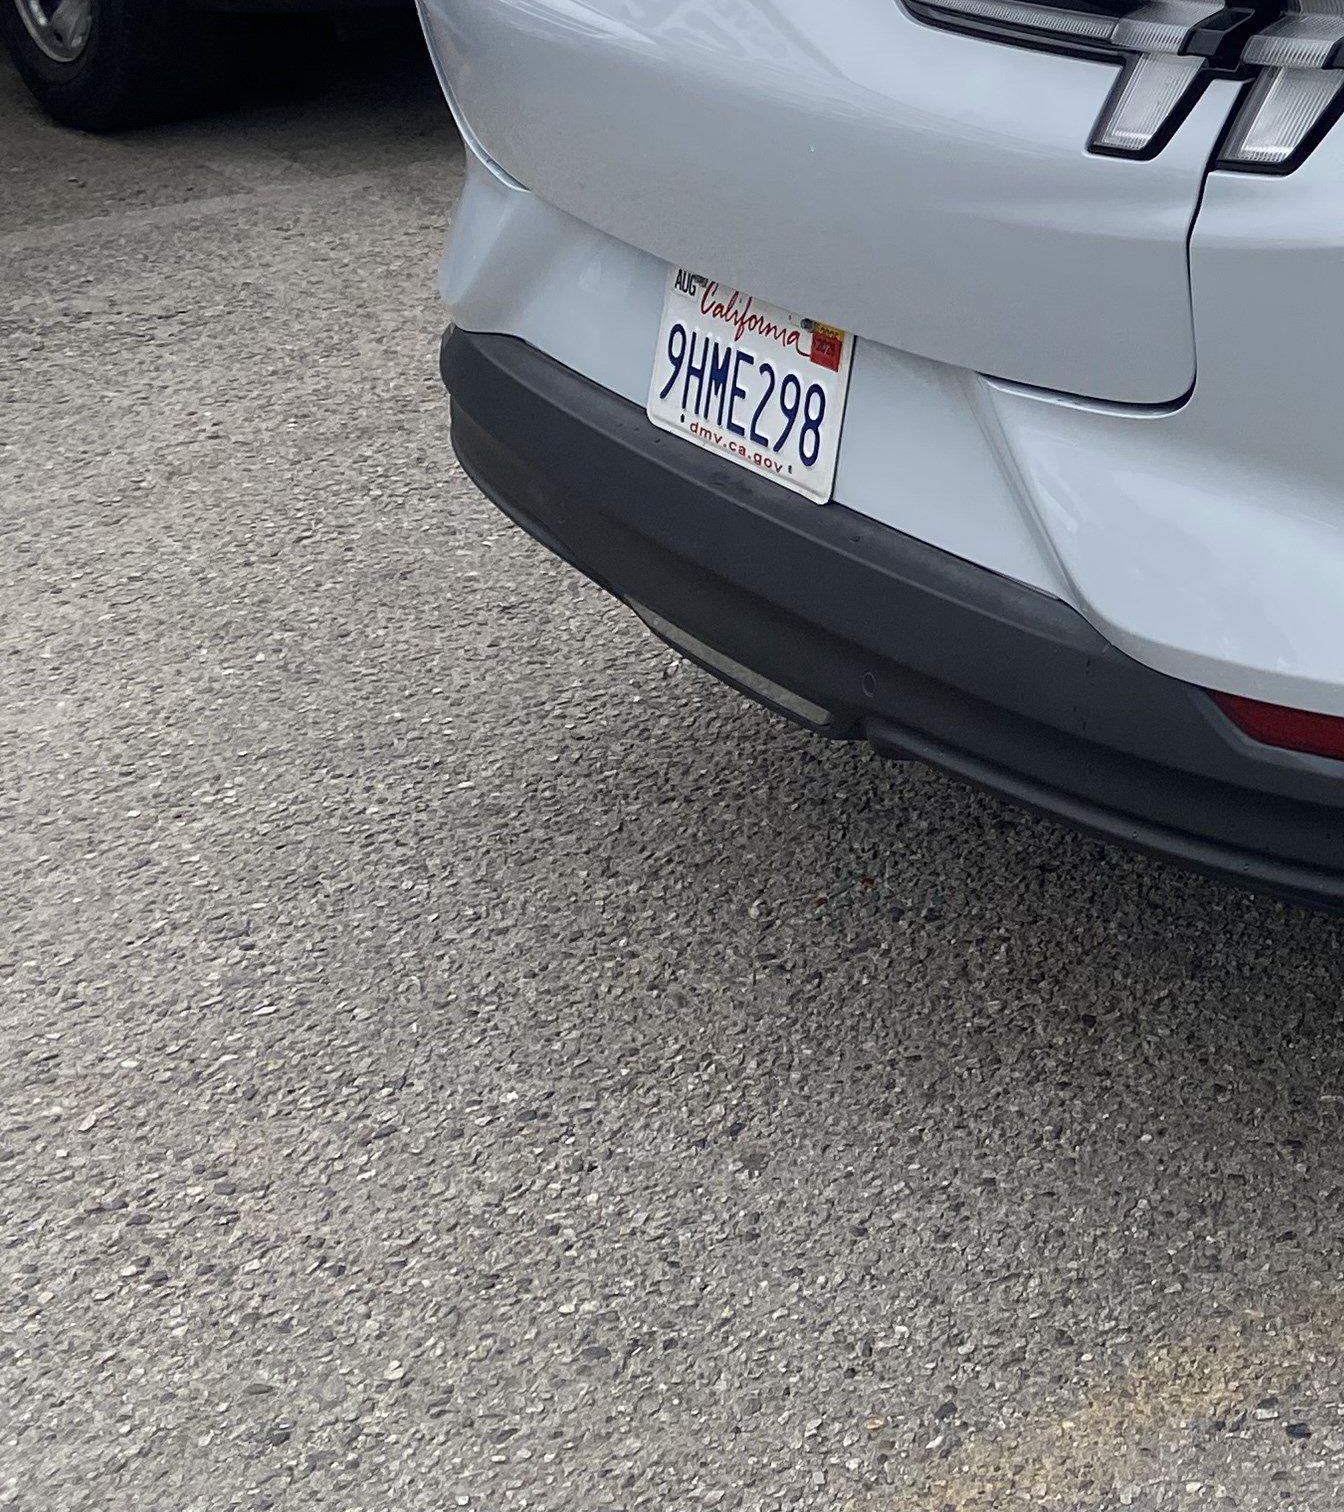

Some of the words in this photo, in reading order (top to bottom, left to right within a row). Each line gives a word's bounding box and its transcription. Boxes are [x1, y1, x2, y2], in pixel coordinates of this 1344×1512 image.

[674, 268, 697, 297] AUG
[700, 280, 811, 358] California
[659, 322, 826, 467] 9HME298
[689, 420, 783, 474] dmv.ca.gov
